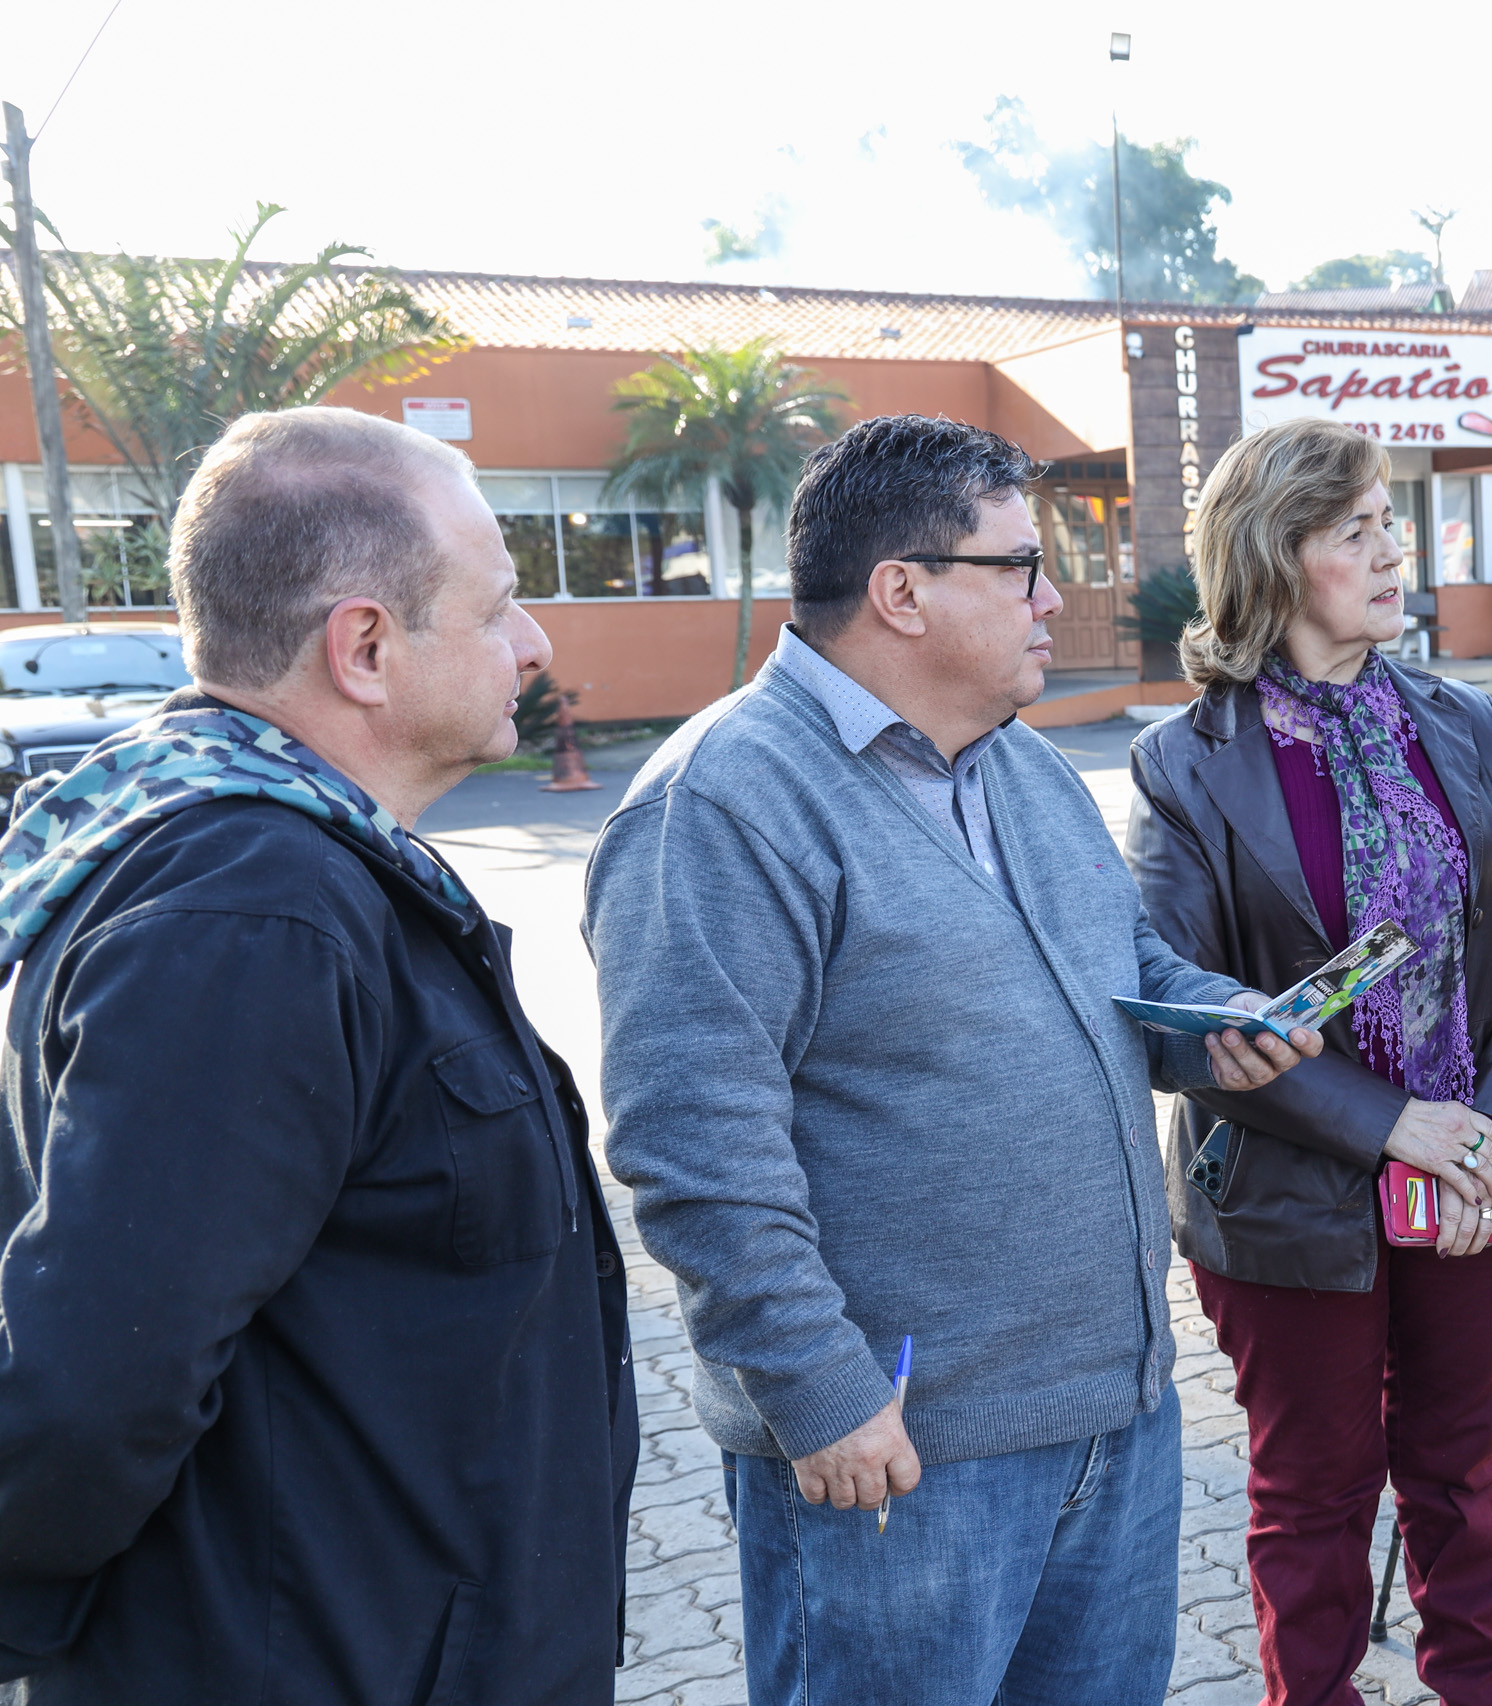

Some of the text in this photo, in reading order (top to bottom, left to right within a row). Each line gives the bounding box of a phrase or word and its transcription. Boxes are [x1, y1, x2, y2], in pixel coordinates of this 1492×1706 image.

[1302, 340, 1452, 359] CHURRASCARIA
[1252, 354, 1492, 411] Sapatão
[1343, 422, 1446, 441] 93 2476
